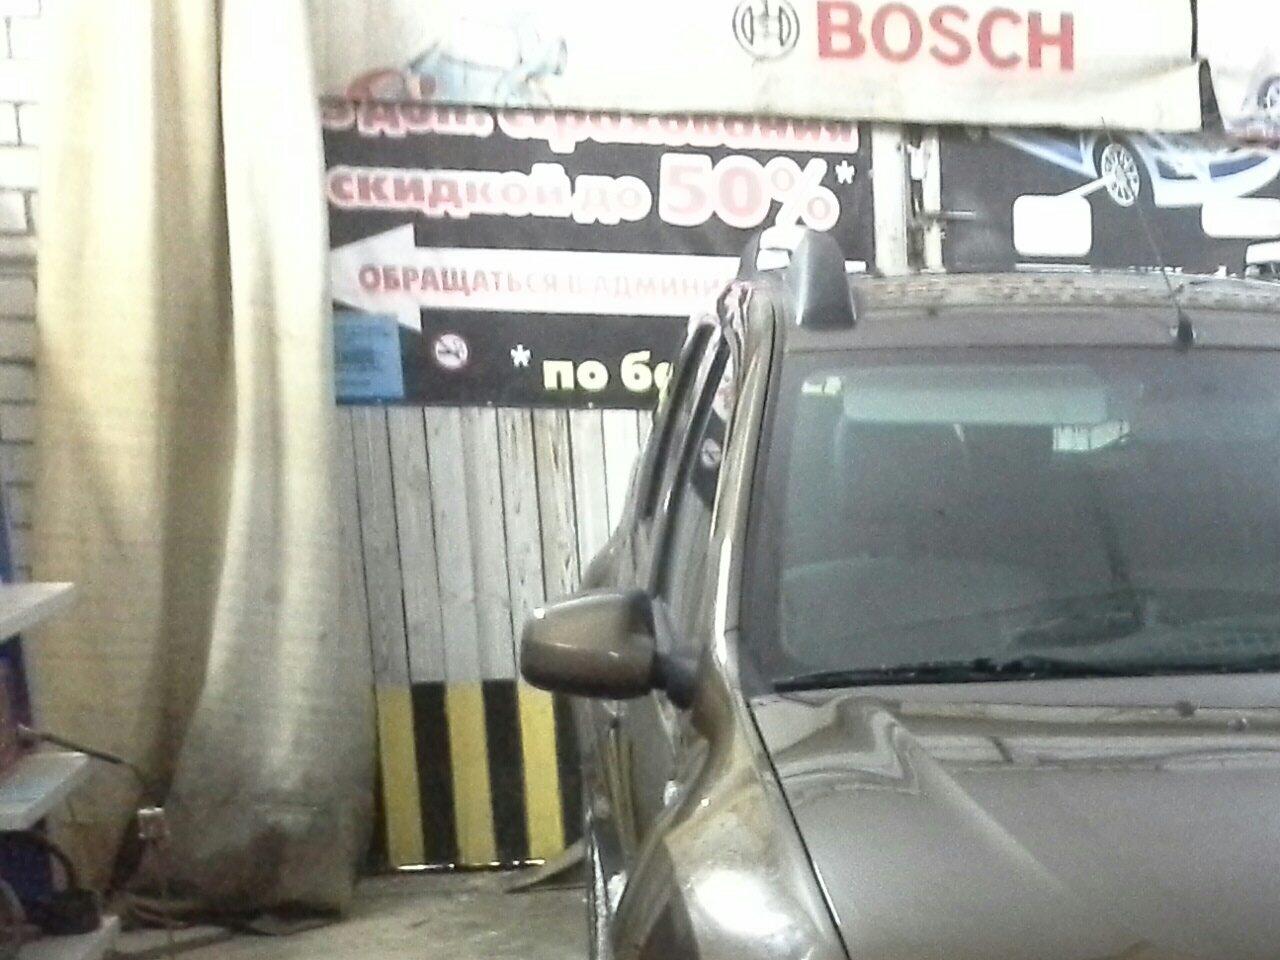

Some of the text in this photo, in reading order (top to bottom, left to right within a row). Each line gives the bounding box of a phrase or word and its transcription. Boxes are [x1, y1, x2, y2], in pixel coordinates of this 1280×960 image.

[817, 0, 1074, 71] BOSCH
[328, 170, 566, 210] скидкой
[581, 180, 643, 214] до
[358, 264, 557, 296] ОБРАЩАТЬСЯ
